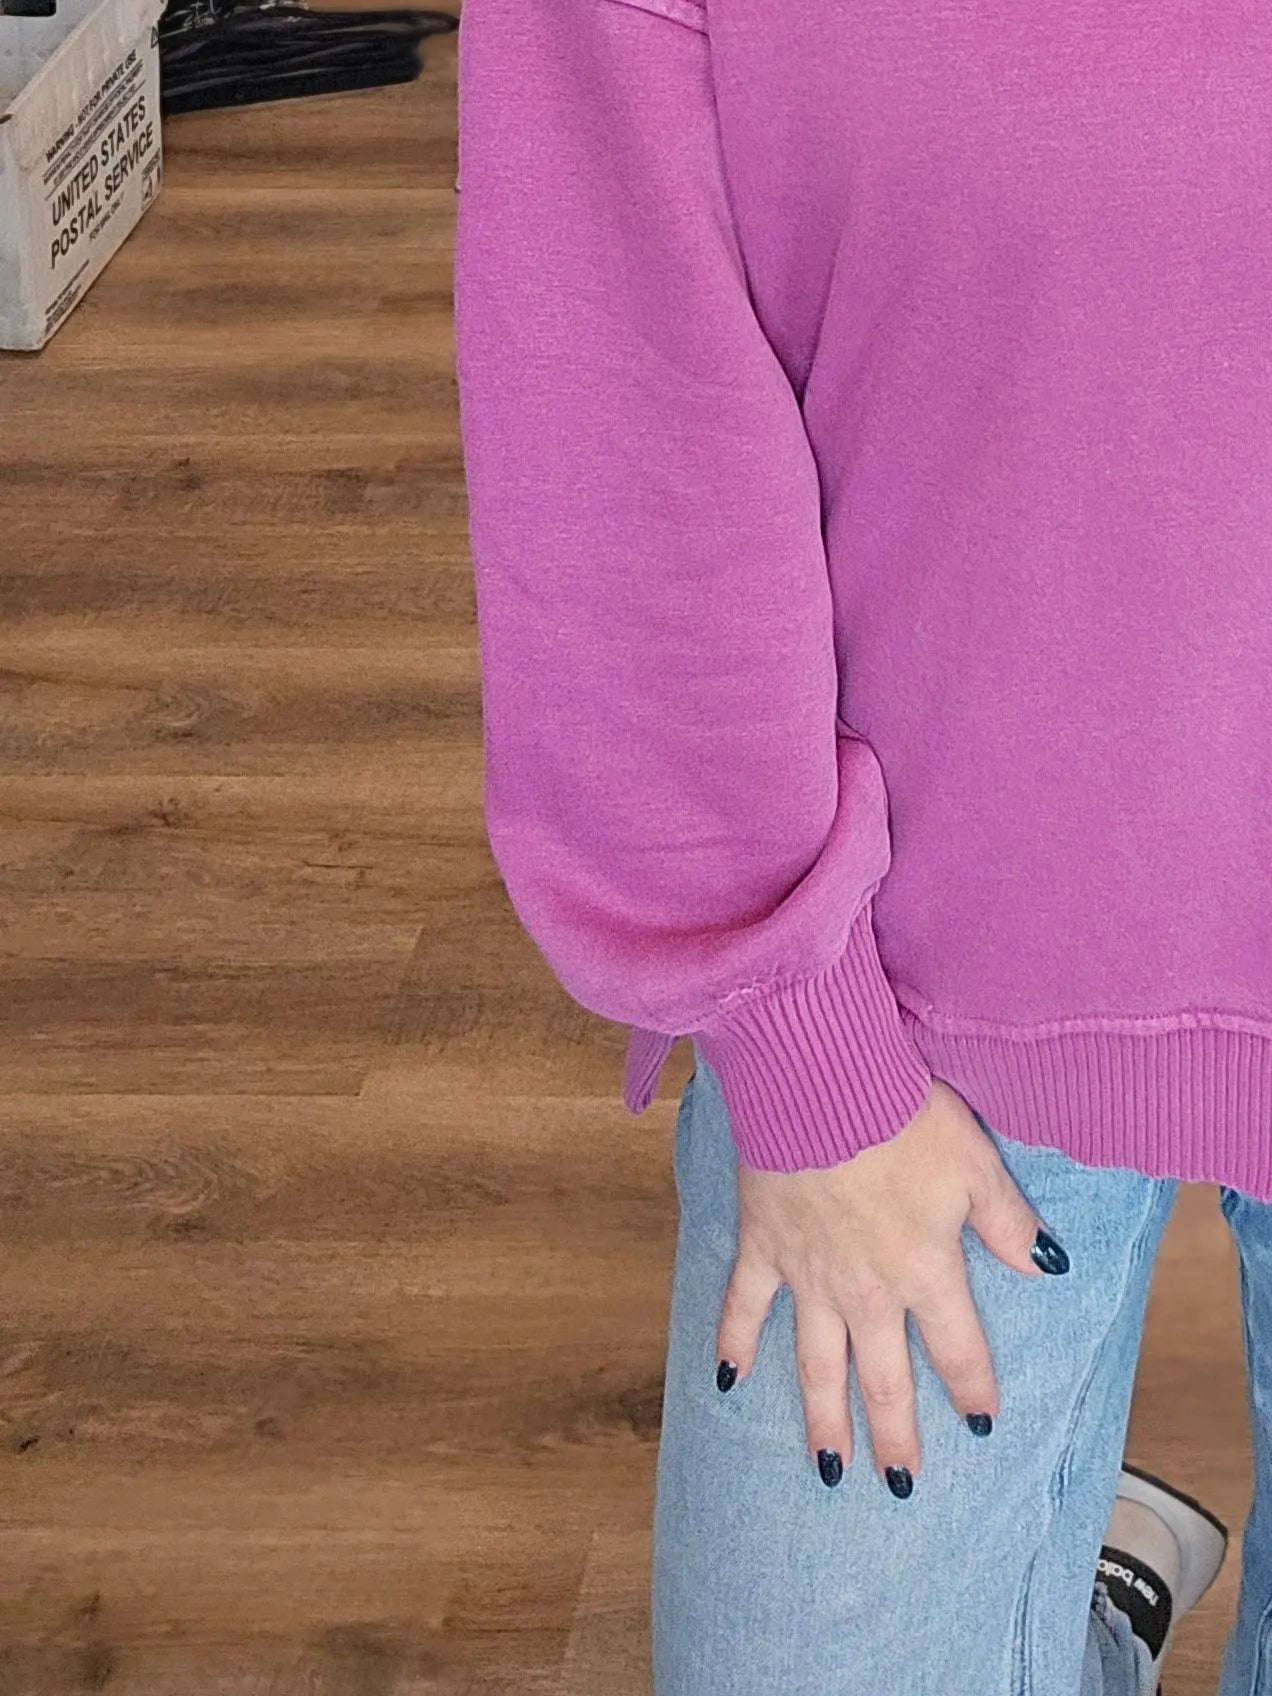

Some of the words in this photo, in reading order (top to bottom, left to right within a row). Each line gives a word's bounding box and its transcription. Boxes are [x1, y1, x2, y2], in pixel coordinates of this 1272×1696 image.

[51, 189, 102, 270] POSTAL
[104, 120, 153, 201] SERVICE
[52, 154, 98, 226] UNITED
[101, 95, 145, 166] STATES
[1133, 1577, 1159, 1607] new
